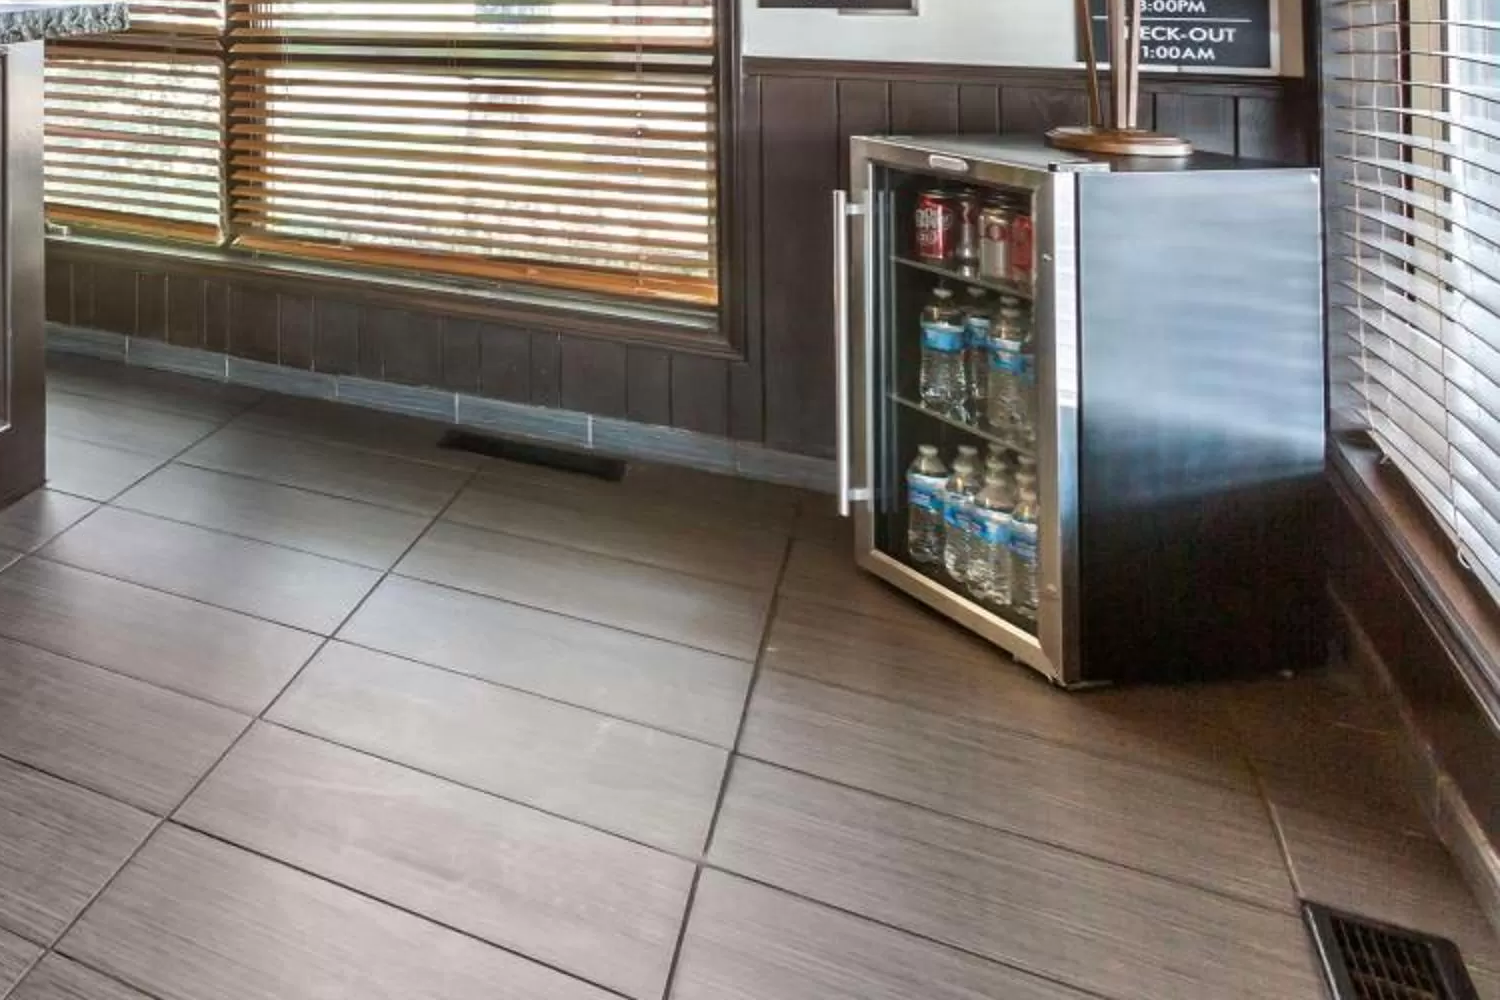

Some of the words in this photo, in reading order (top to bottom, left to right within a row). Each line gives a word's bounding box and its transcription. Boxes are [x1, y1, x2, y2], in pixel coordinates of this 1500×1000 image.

[1139, 0, 1207, 13] 3:00PM
[1123, 25, 1237, 43] ECK-OUT
[1140, 45, 1216, 61] 1:00AM
